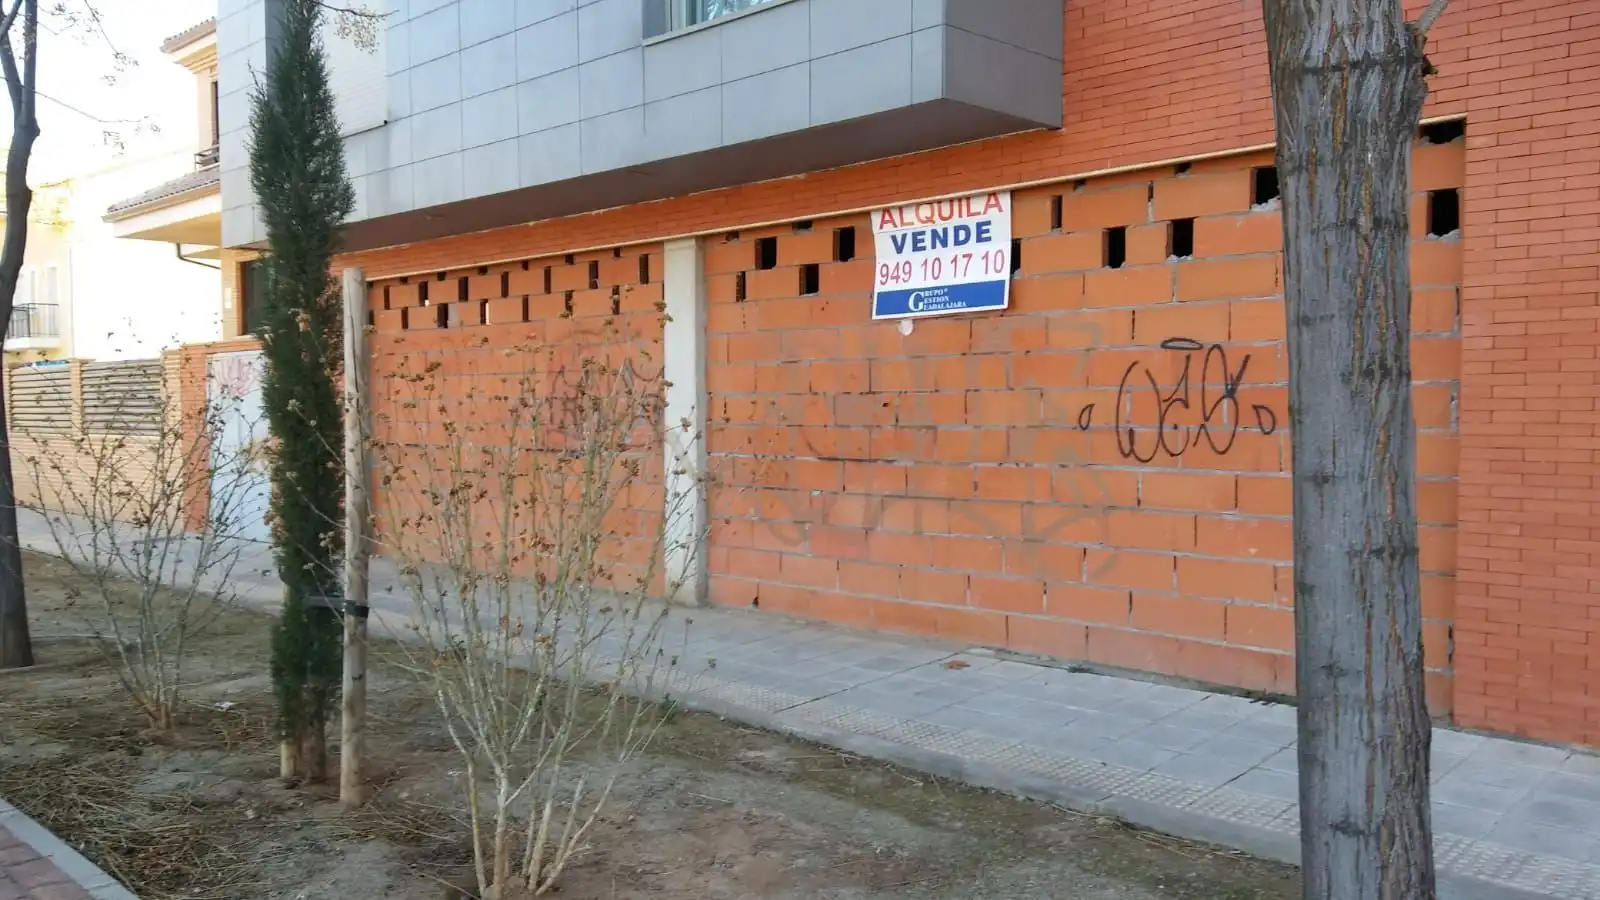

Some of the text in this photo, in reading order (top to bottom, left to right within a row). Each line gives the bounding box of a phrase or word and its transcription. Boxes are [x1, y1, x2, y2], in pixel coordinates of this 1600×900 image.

[879, 193, 1003, 230] ALQUILA
[890, 220, 992, 254] VENDE
[879, 249, 1005, 286] 949 10 17 10
